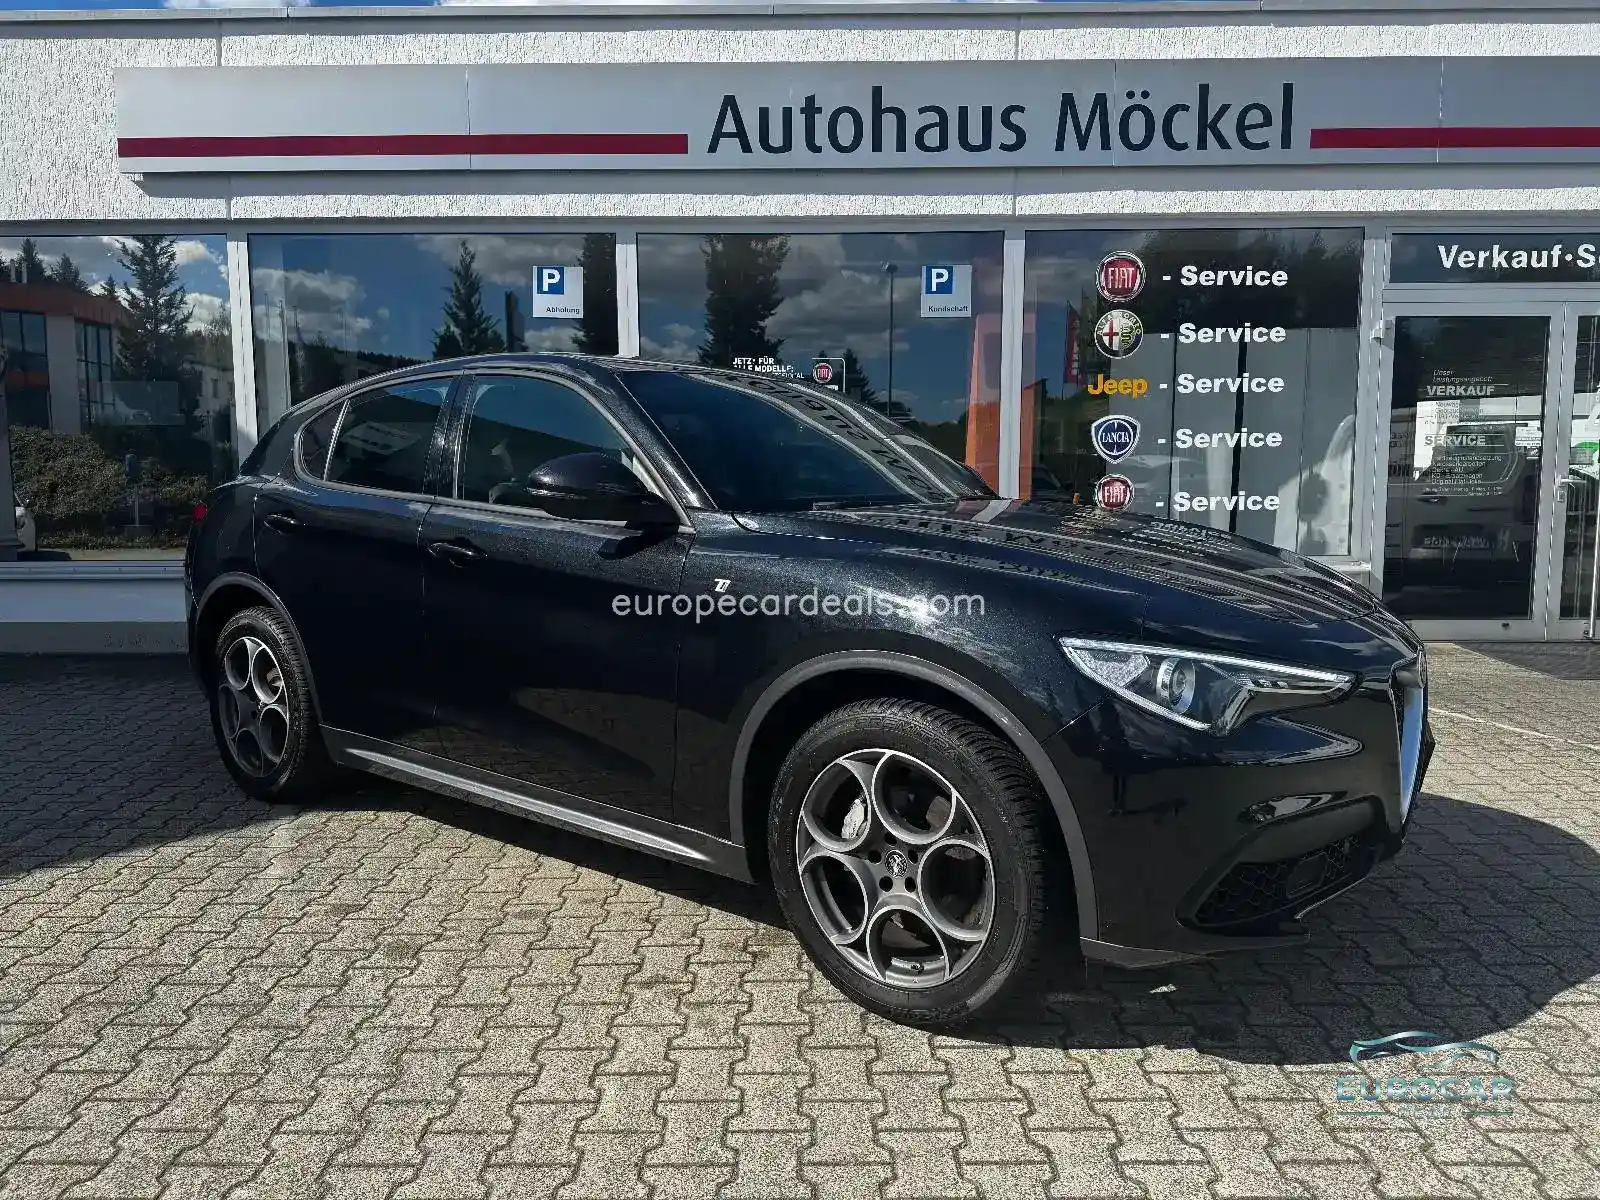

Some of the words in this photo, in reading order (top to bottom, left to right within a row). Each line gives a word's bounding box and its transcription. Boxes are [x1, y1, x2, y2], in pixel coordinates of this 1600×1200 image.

[708, 86, 1026, 154] Autohaus
[1055, 83, 1294, 152] Möckel
[543, 268, 561, 292] P
[931, 268, 949, 292] P
[1107, 266, 1135, 289] FIAT
[1181, 265, 1288, 287] Service
[546, 306, 581, 315] Abholung
[1179, 322, 1286, 344] Service
[758, 355, 775, 365] FÜR
[1087, 373, 1149, 398] Jeep
[1178, 372, 1285, 394] Service
[1426, 385, 1495, 396] VERKAUF
[1102, 431, 1130, 443] LANCIA
[1176, 427, 1283, 449] Service
[1424, 435, 1487, 446] SERVICE
[1104, 485, 1126, 503] FIAT
[1174, 490, 1281, 512] Service
